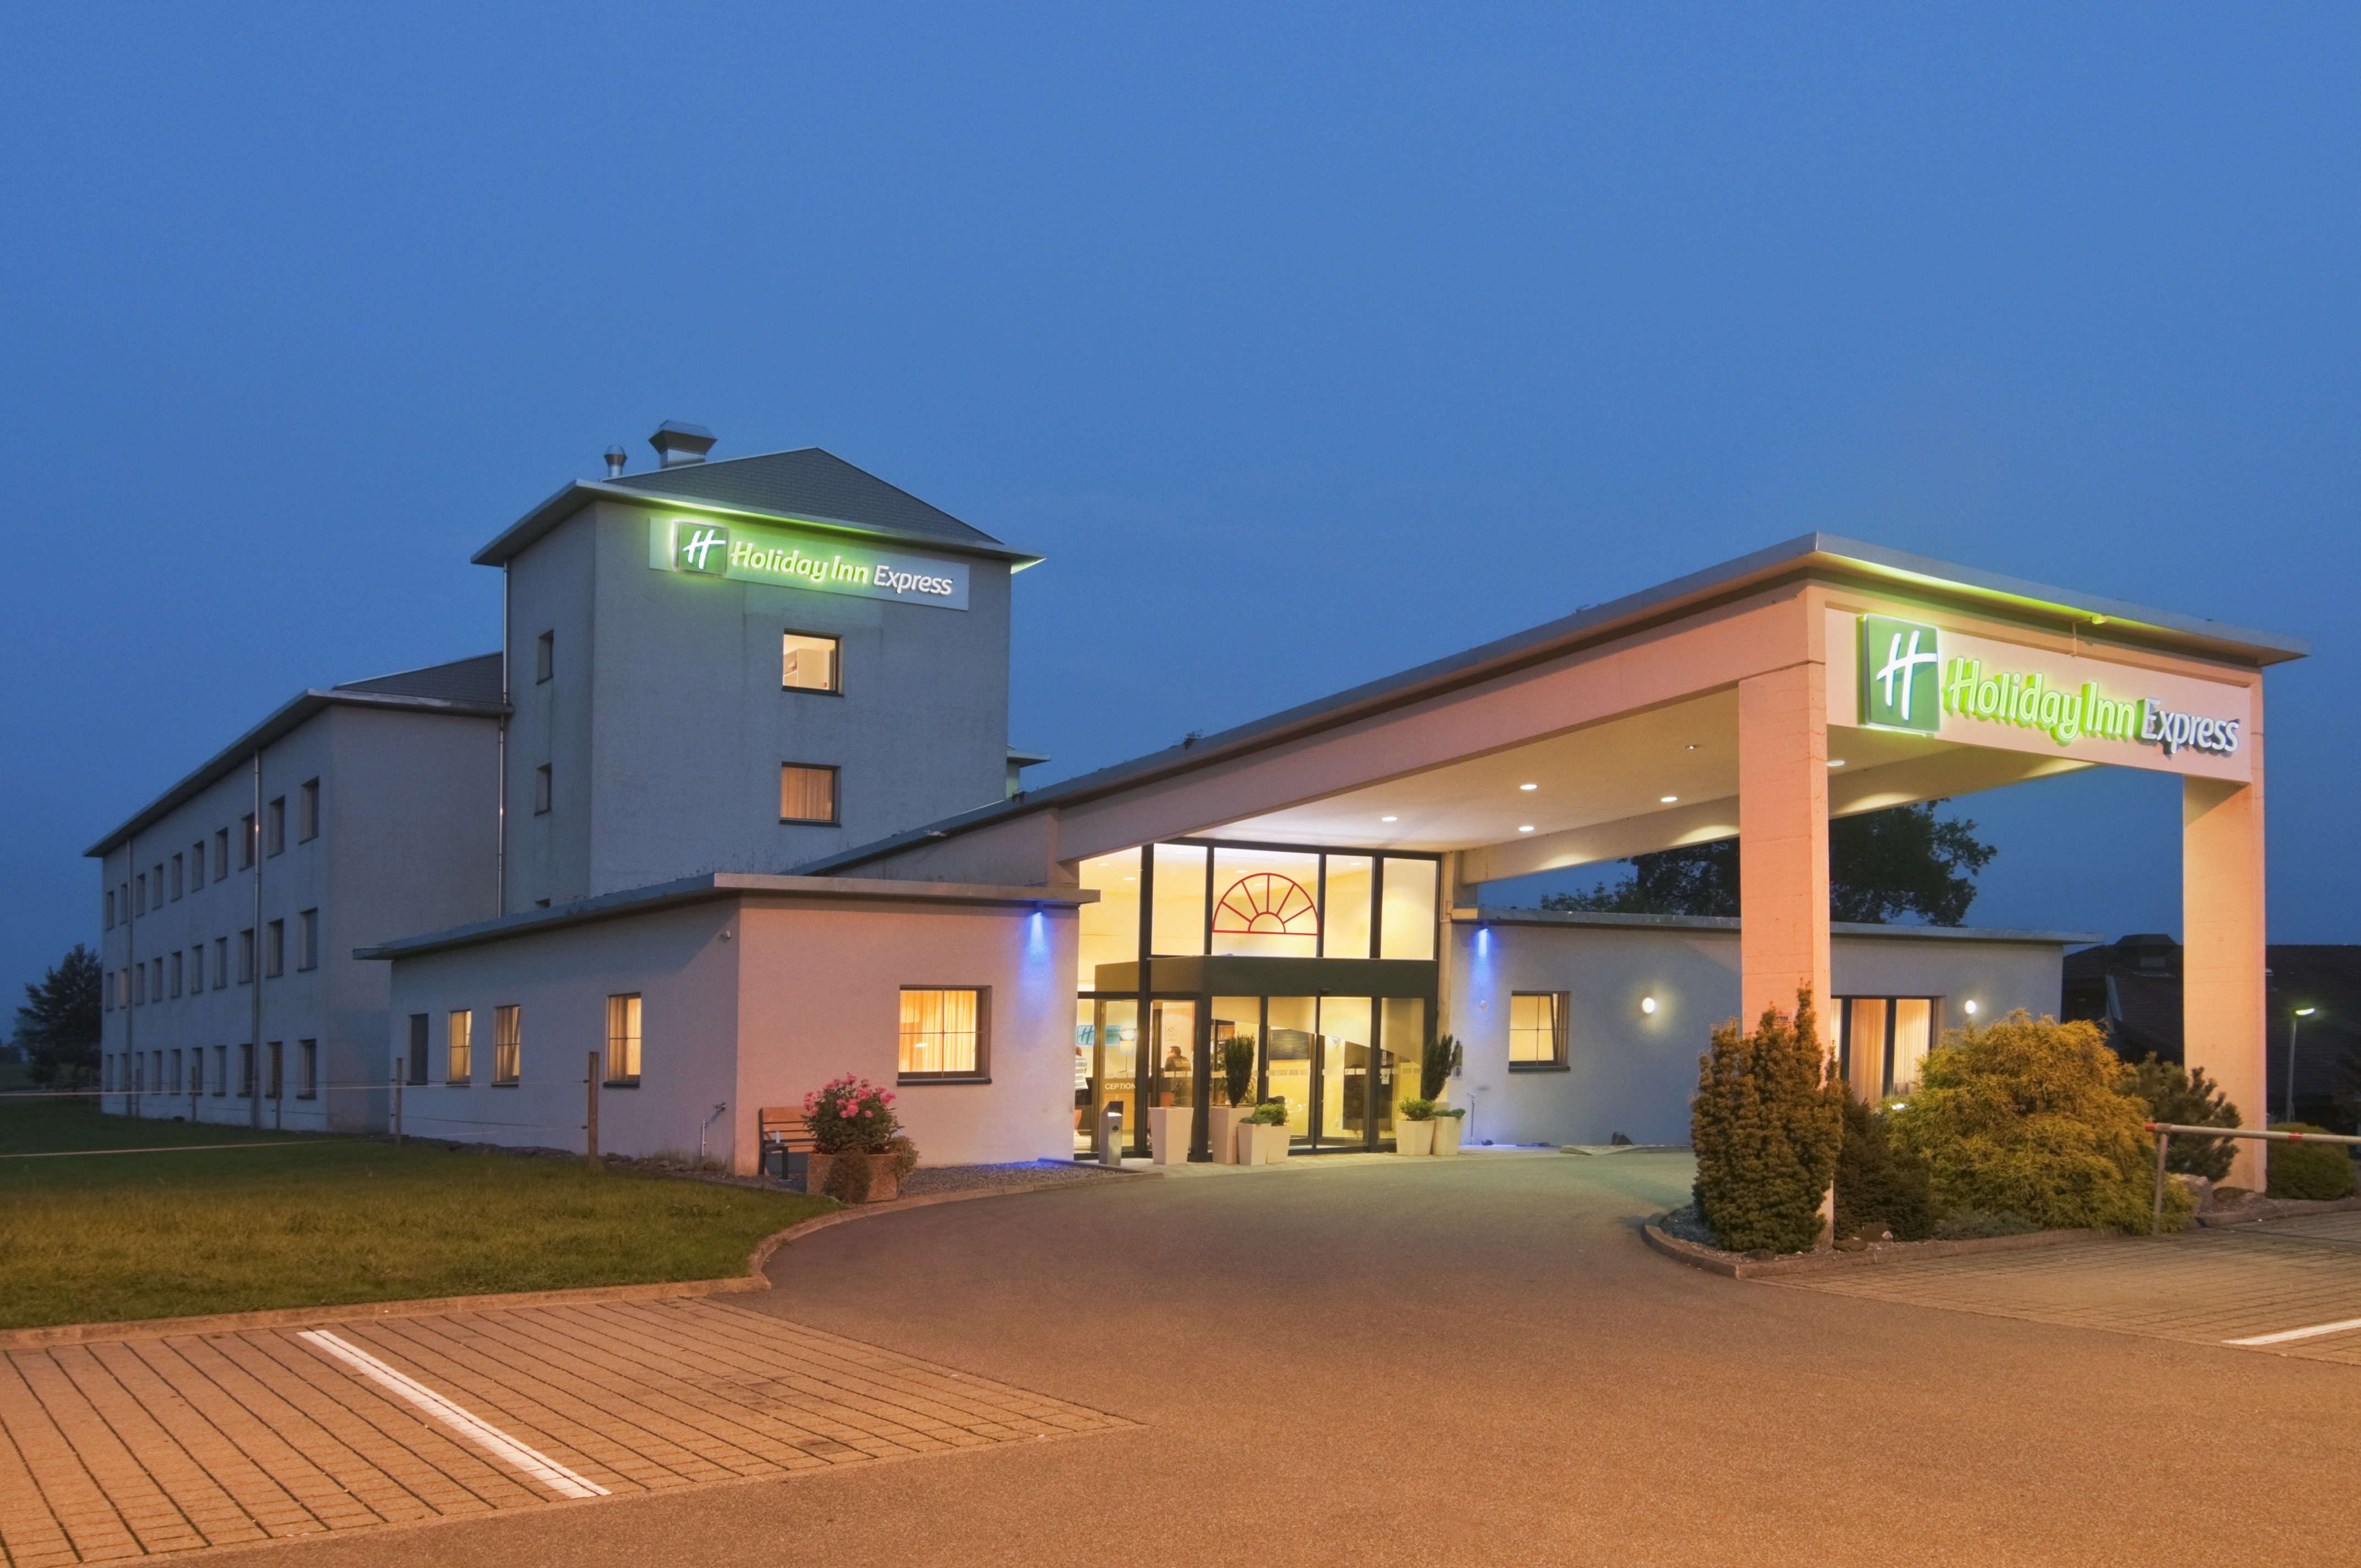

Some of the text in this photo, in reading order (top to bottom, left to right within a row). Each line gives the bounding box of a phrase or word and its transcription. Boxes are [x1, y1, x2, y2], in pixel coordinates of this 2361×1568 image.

[683, 529, 953, 595] H Holiday Inn Express
[1876, 629, 2239, 754] H Holiday Inn Express
